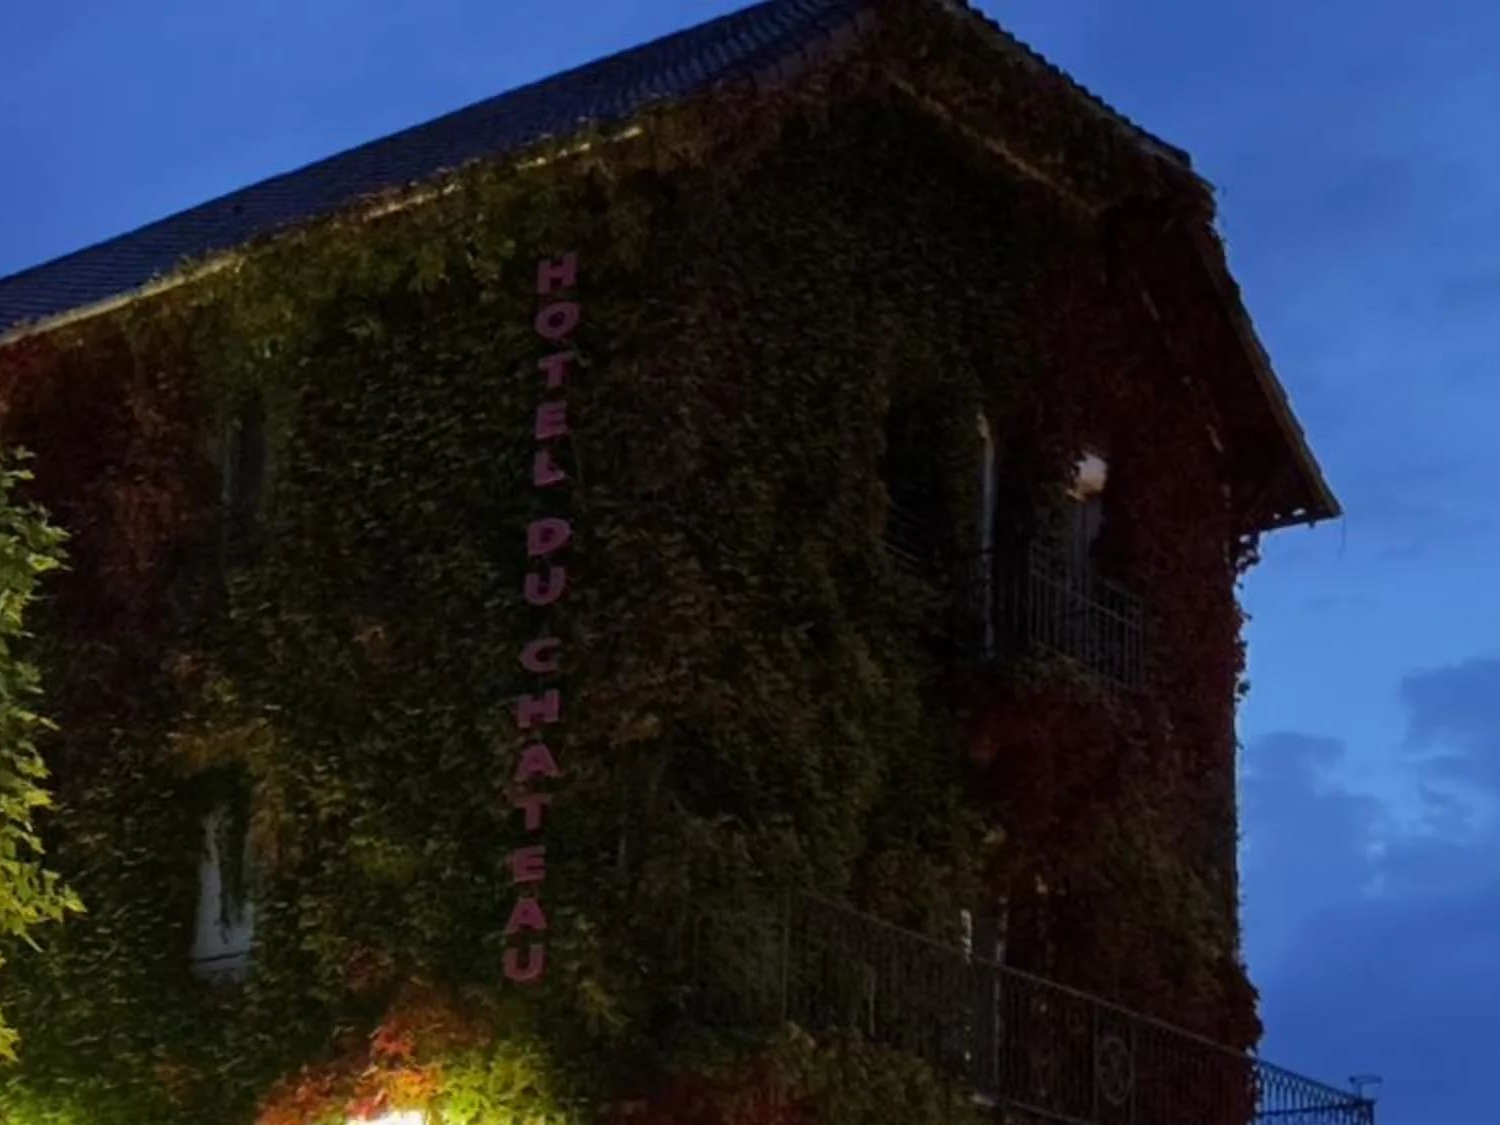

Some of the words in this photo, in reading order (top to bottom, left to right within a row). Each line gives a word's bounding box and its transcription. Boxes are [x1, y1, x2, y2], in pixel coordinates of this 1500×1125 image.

[533, 251, 582, 487] HOTEL
[523, 516, 573, 606] DU
[503, 636, 566, 982] CHATEAU
